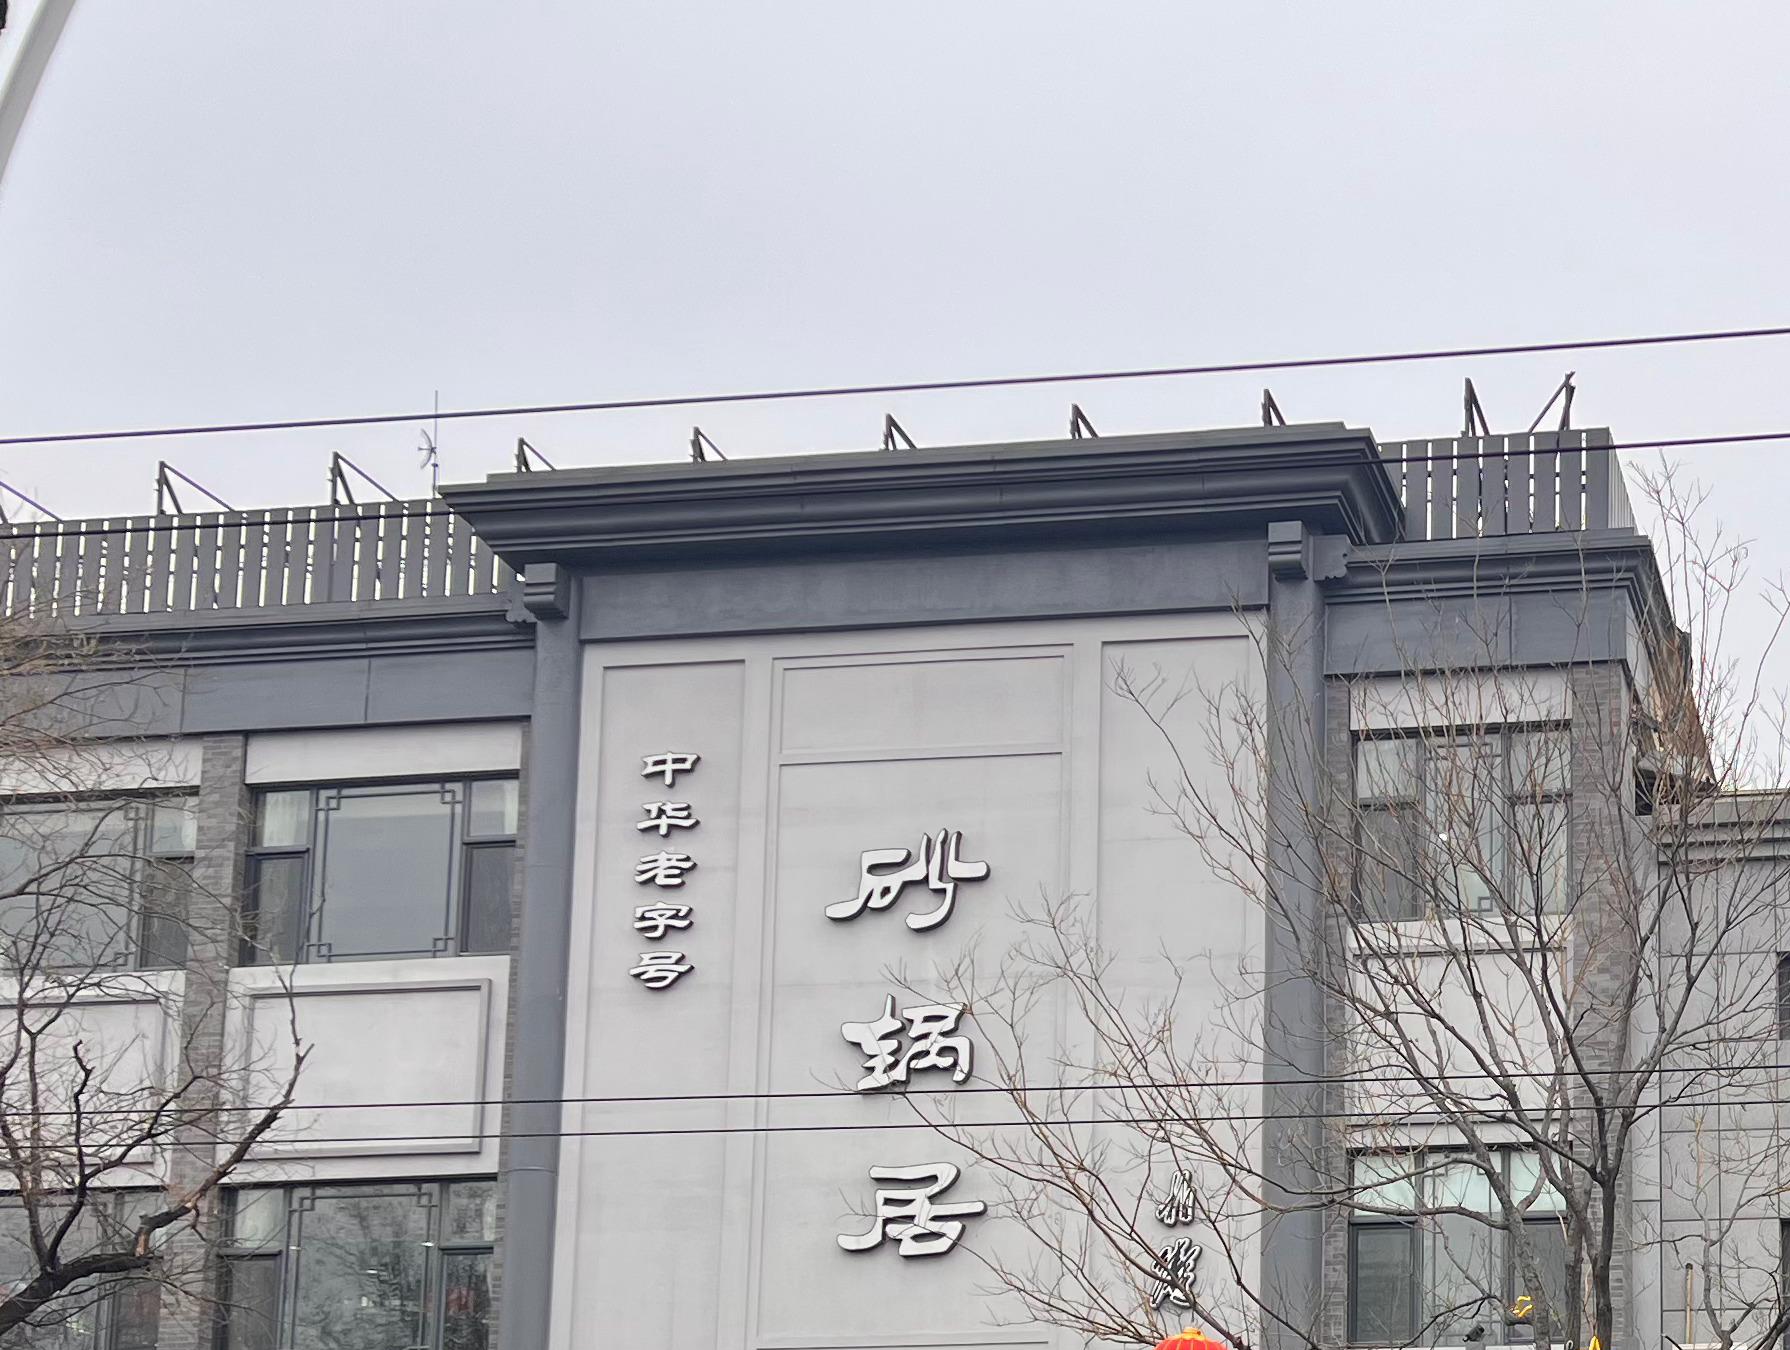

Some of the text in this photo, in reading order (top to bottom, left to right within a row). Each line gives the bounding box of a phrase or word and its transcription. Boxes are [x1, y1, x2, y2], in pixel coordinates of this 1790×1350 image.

[629, 750, 700, 990] 中华老字号
[824, 827, 990, 1258] 砂锅居
